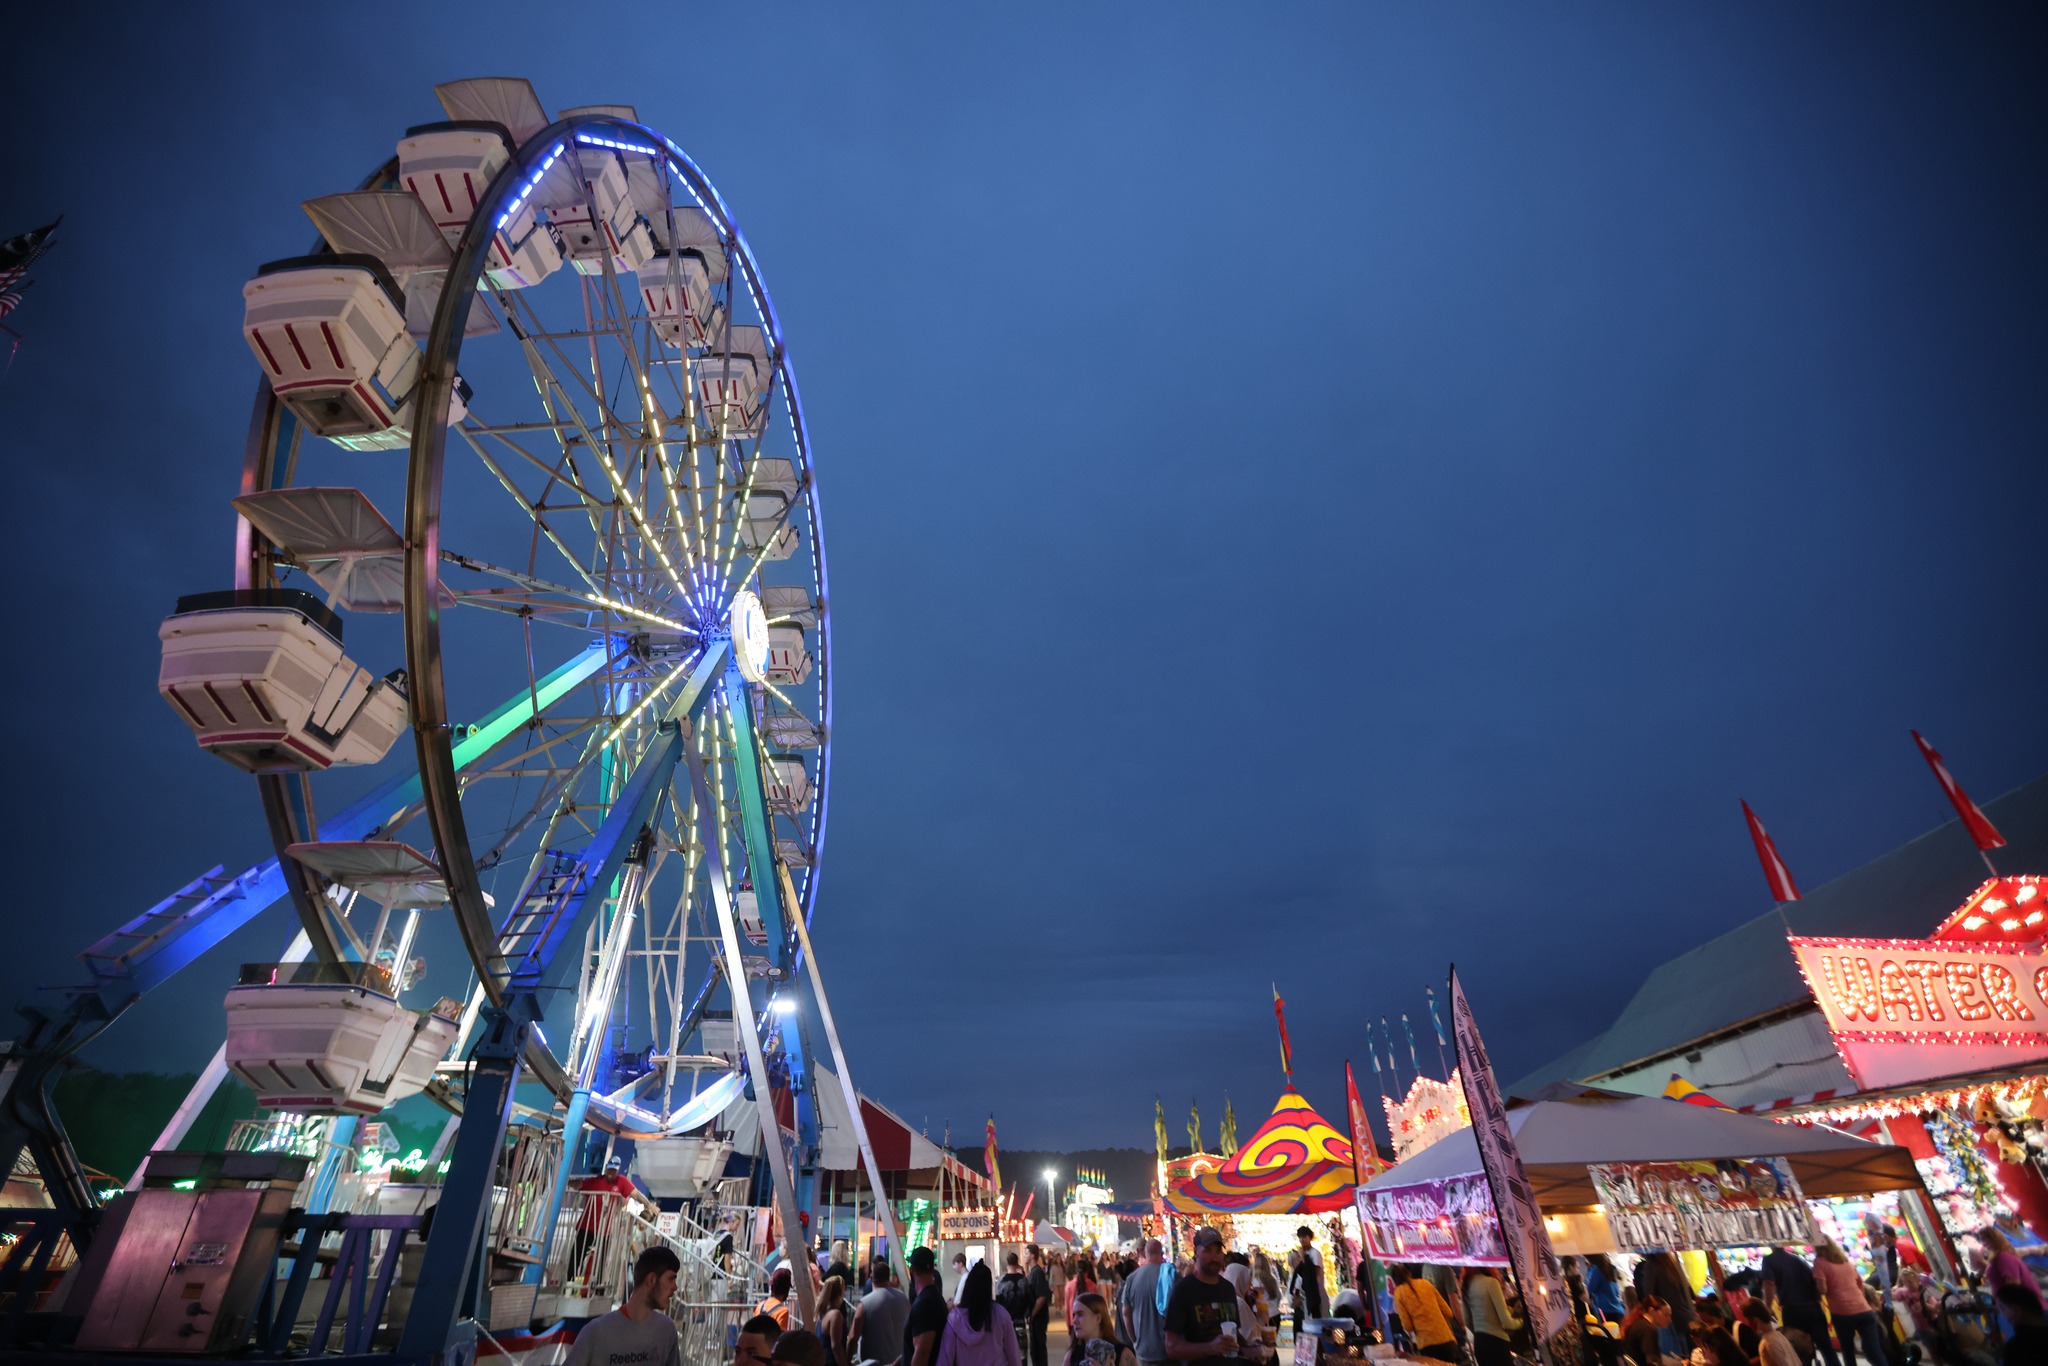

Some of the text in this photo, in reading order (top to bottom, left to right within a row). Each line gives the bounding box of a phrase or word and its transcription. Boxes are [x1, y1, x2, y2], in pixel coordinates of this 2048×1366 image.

[1821, 955, 2036, 1022] WATER
[943, 1215, 990, 1228] COUPONS
[609, 1350, 649, 1366] Reebok
